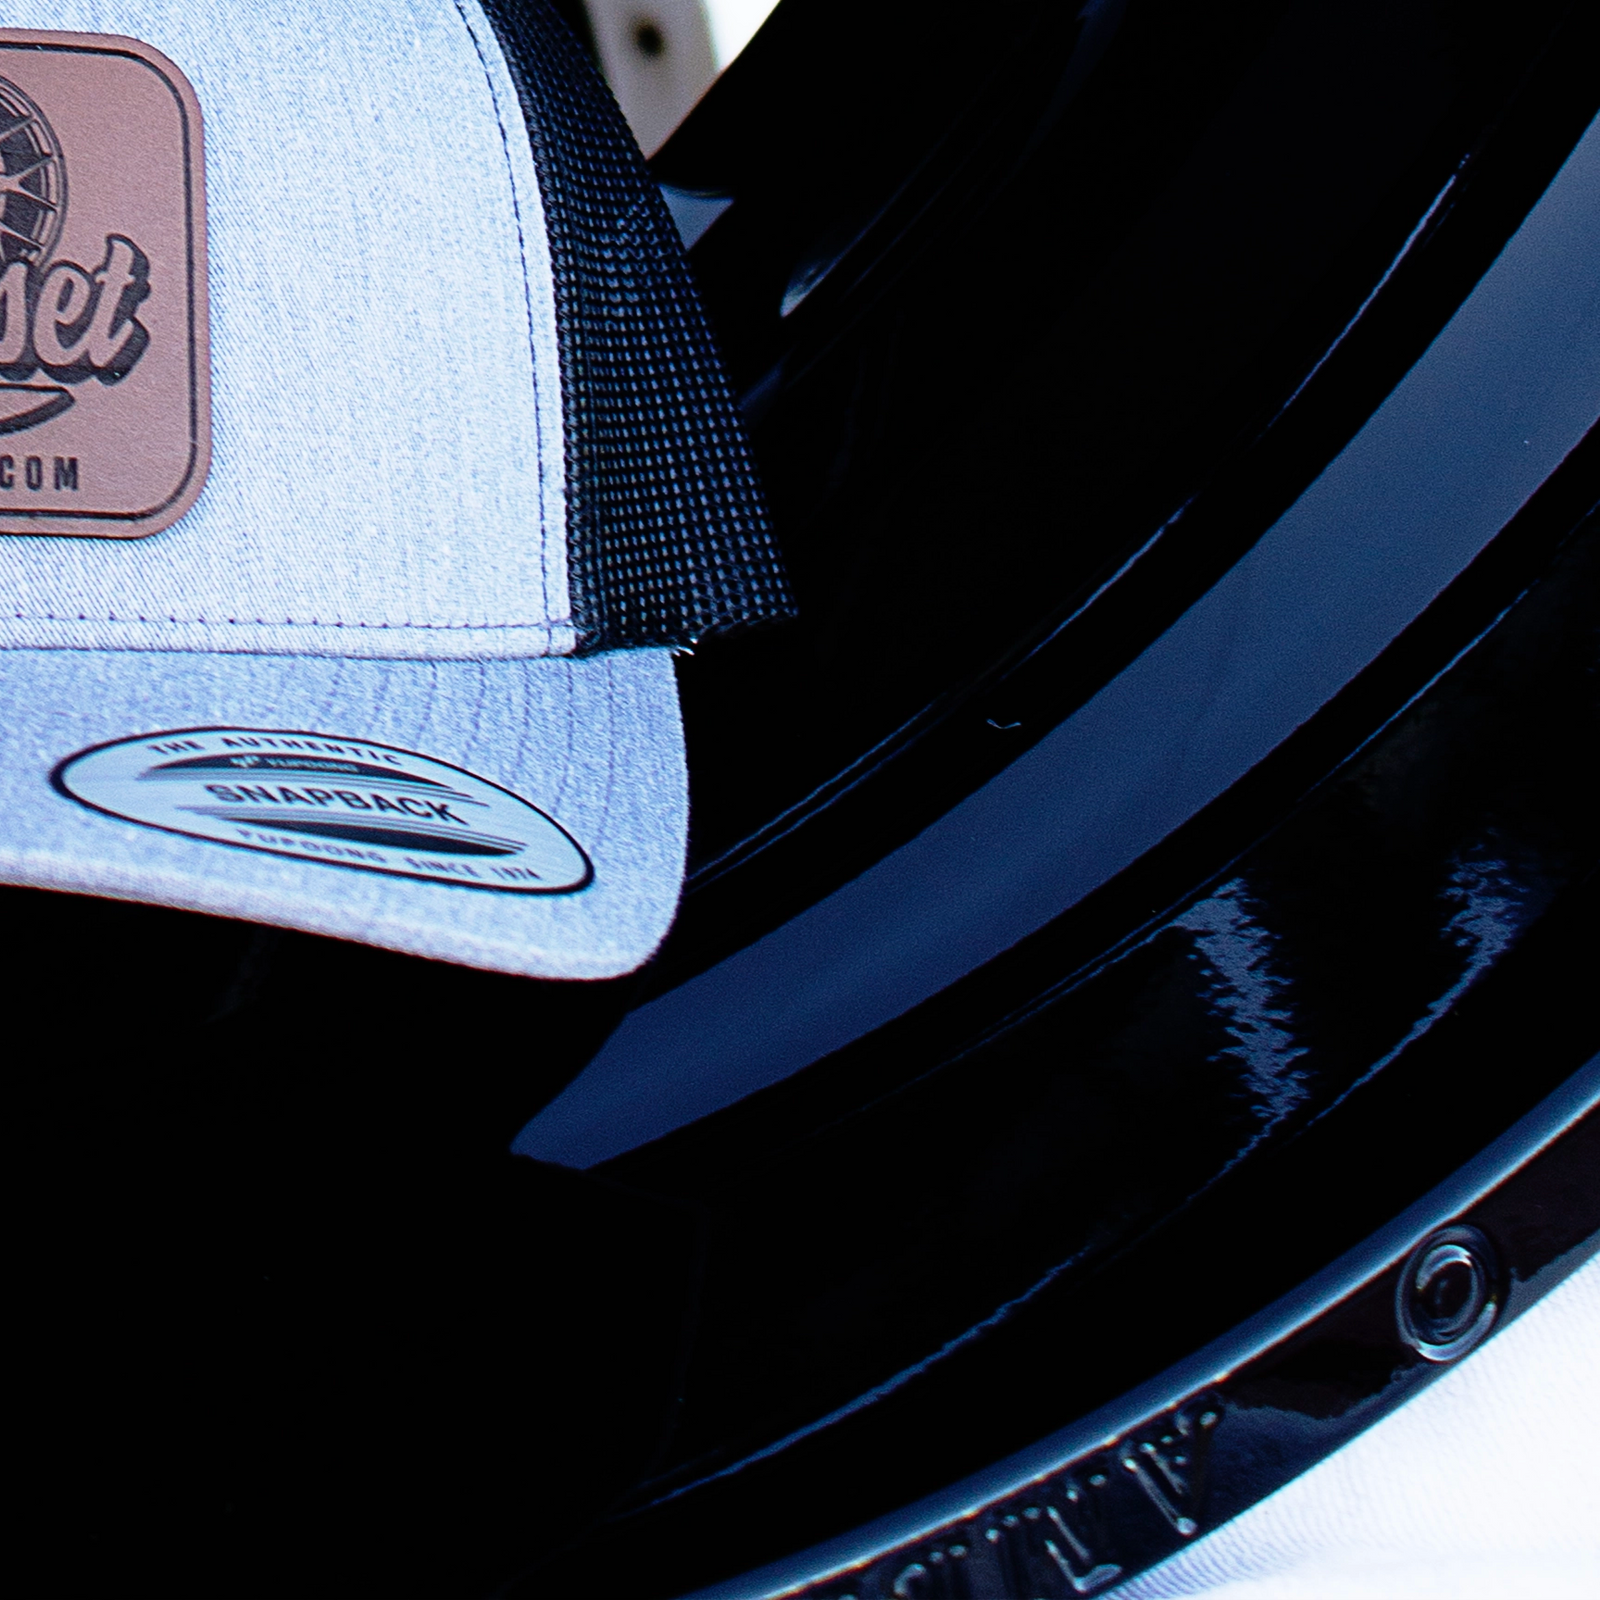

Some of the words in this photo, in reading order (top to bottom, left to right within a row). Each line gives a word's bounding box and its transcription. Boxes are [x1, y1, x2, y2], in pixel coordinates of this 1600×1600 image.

[148, 740, 205, 756] THE
[221, 736, 403, 766] AUTHENTIC
[203, 783, 470, 827] SNAPBACK
[236, 828, 388, 863] YUPOONG
[403, 855, 483, 878] SINCE
